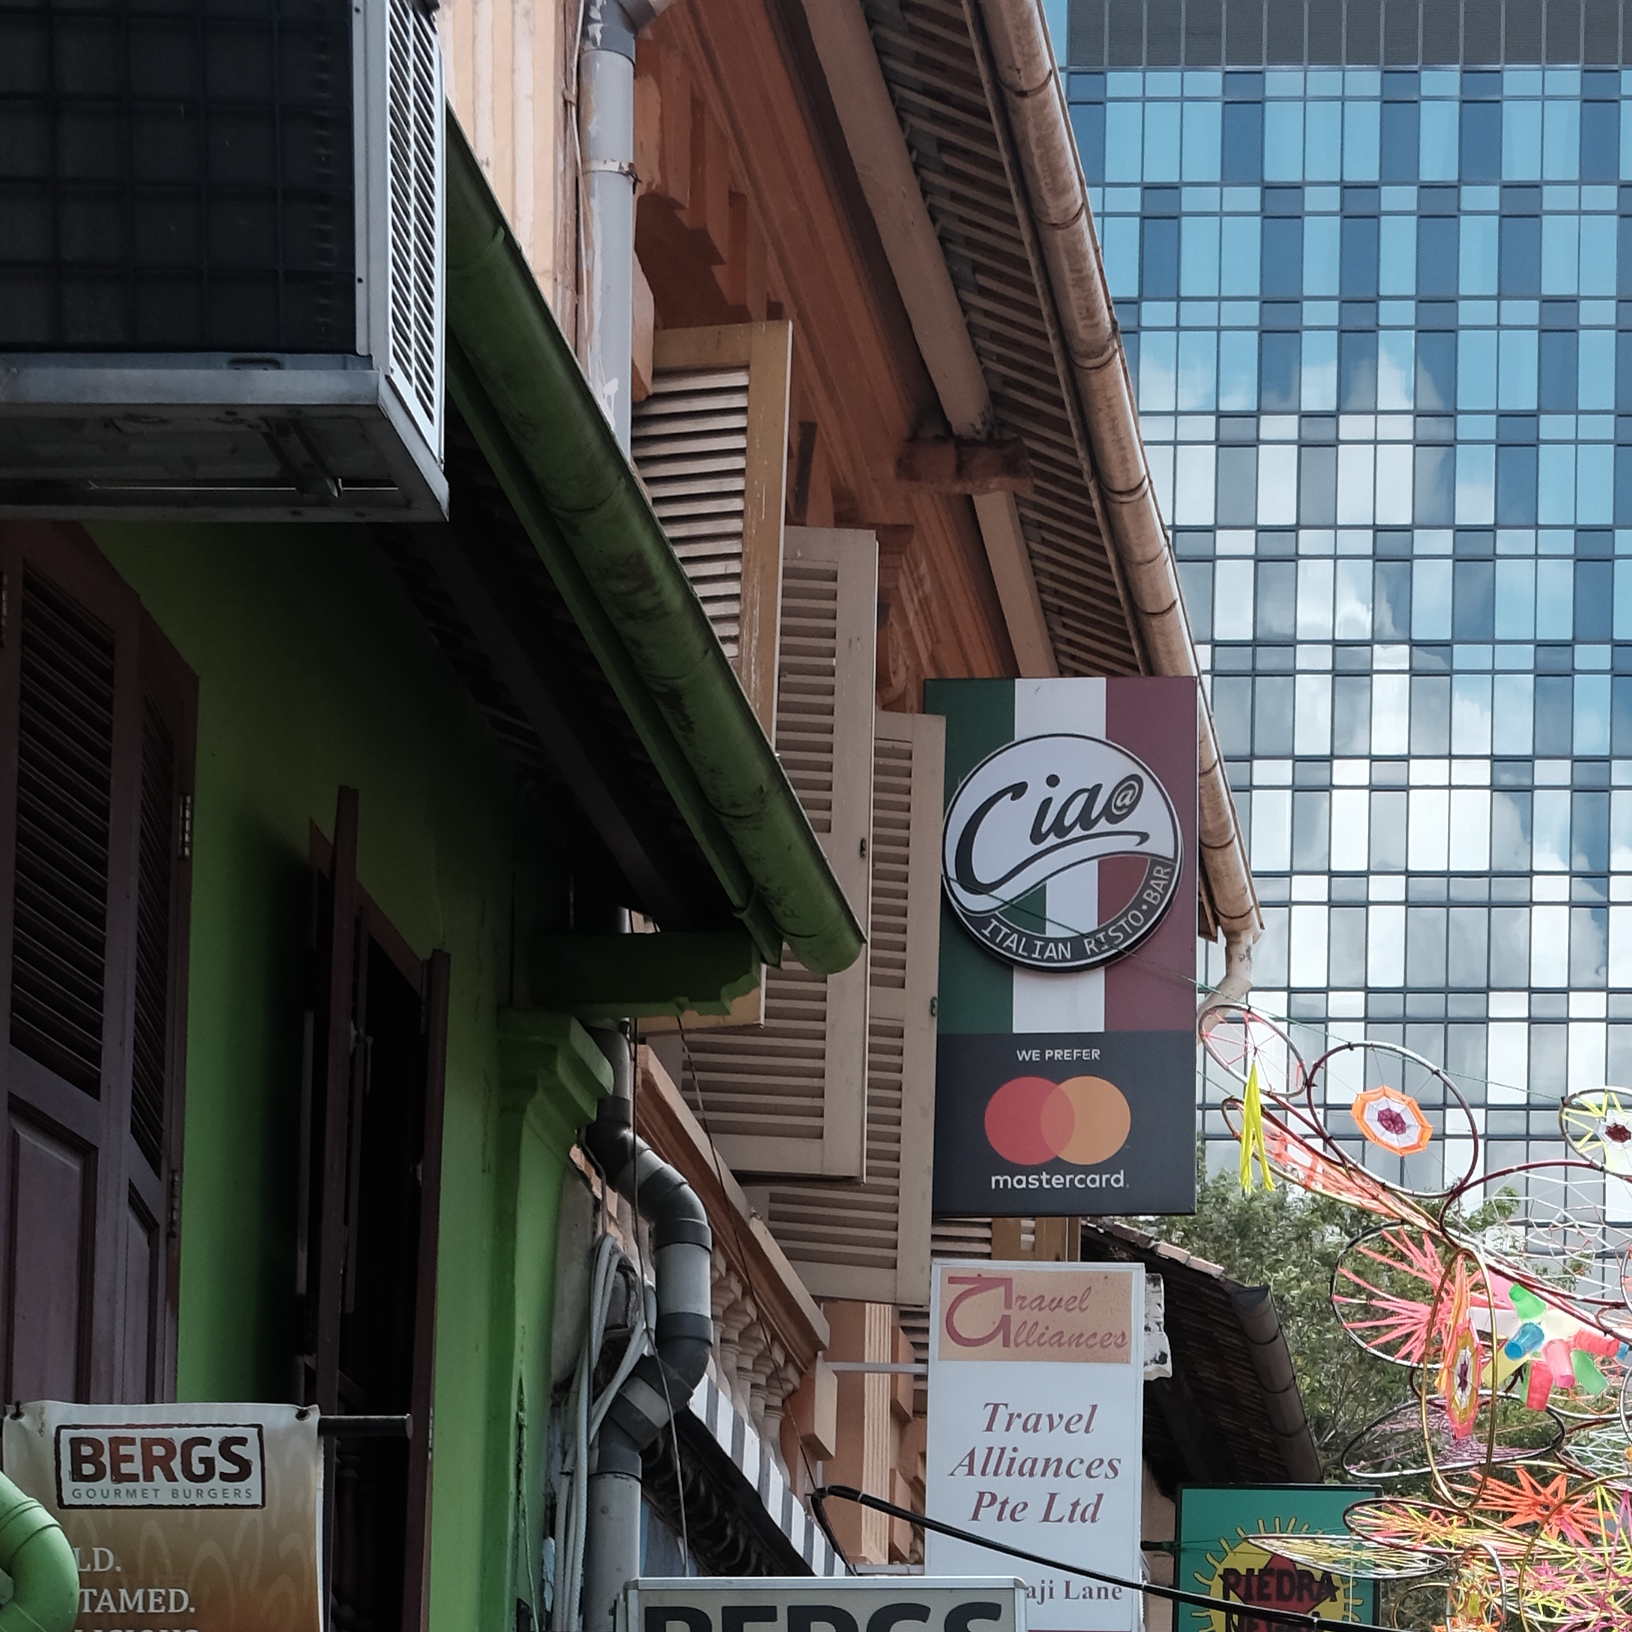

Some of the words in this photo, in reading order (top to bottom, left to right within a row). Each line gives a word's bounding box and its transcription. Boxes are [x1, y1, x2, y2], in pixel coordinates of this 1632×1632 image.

[981, 917, 1072, 962] ITALIAN
[1016, 1048, 1041, 1062] WE
[1044, 1047, 1101, 1062] PREFER
[990, 1169, 1126, 1191] mastercard
[982, 1401, 1097, 1435] Travel
[68, 1435, 254, 1484] BERGS
[947, 1446, 1122, 1480] Alliances
[71, 1488, 161, 1500] GOURMET
[171, 1488, 253, 1500] BURGERS
[968, 1491, 1030, 1525] Pte
[1039, 1491, 1106, 1525] Ltd
[73, 1547, 122, 1573] LD.
[1025, 1580, 1057, 1605] aji
[1063, 1580, 1123, 1601] Lane
[1218, 1567, 1341, 1602] PIEDRA
[79, 1588, 196, 1613] TAMED.
